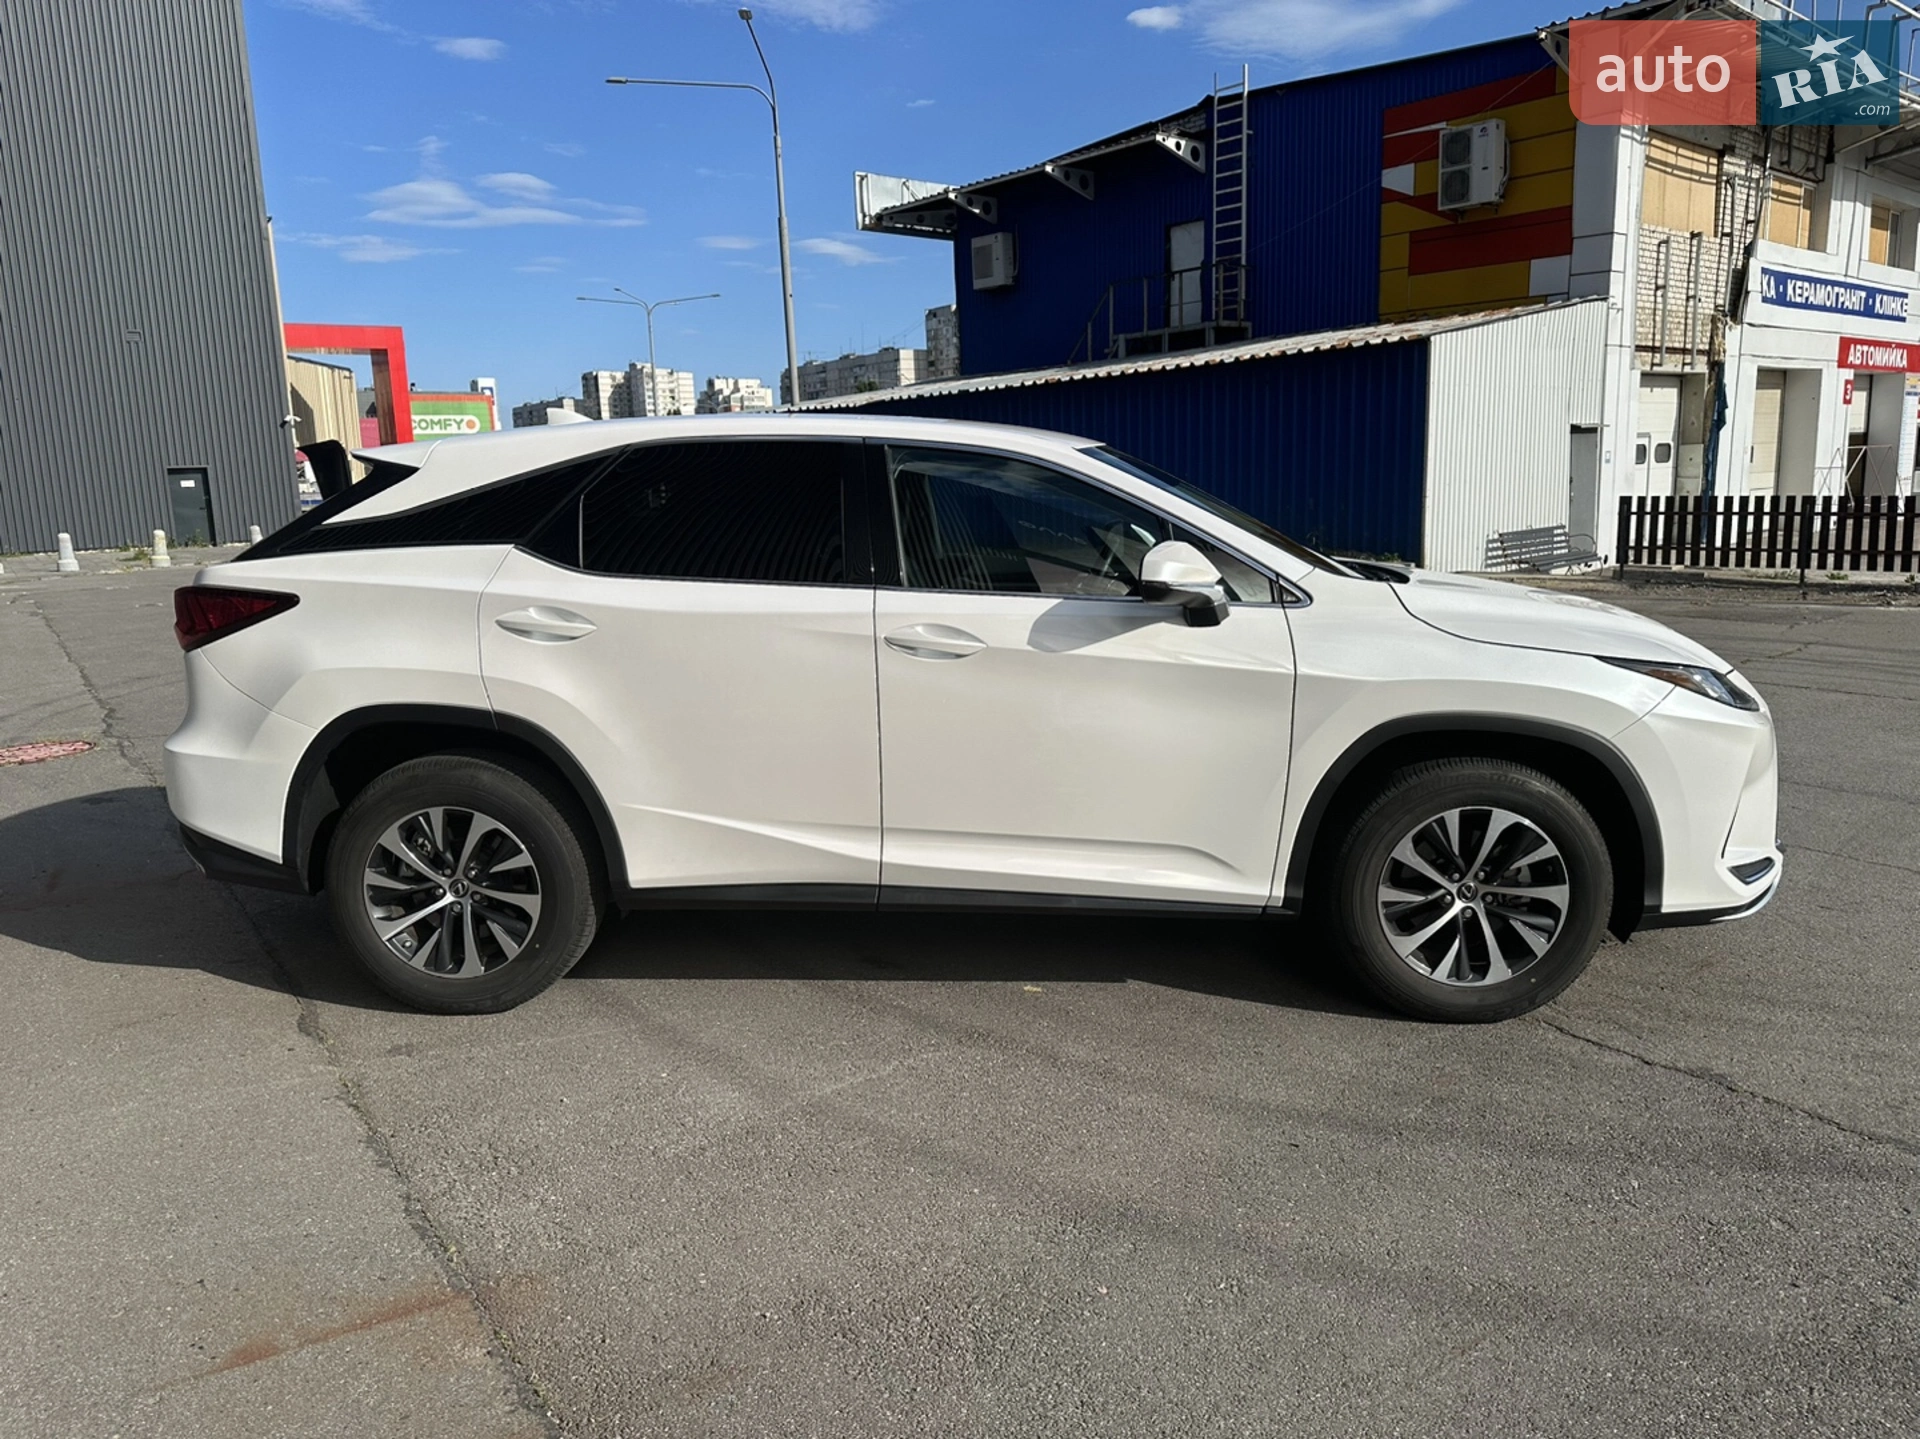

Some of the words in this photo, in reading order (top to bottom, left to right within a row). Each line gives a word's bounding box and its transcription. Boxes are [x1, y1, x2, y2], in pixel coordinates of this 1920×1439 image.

[1786, 278, 1867, 312] КЕРАМОГРАНІТ
[1847, 343, 1908, 369] АВТОМИЙКА
[1845, 384, 1852, 400] 3
